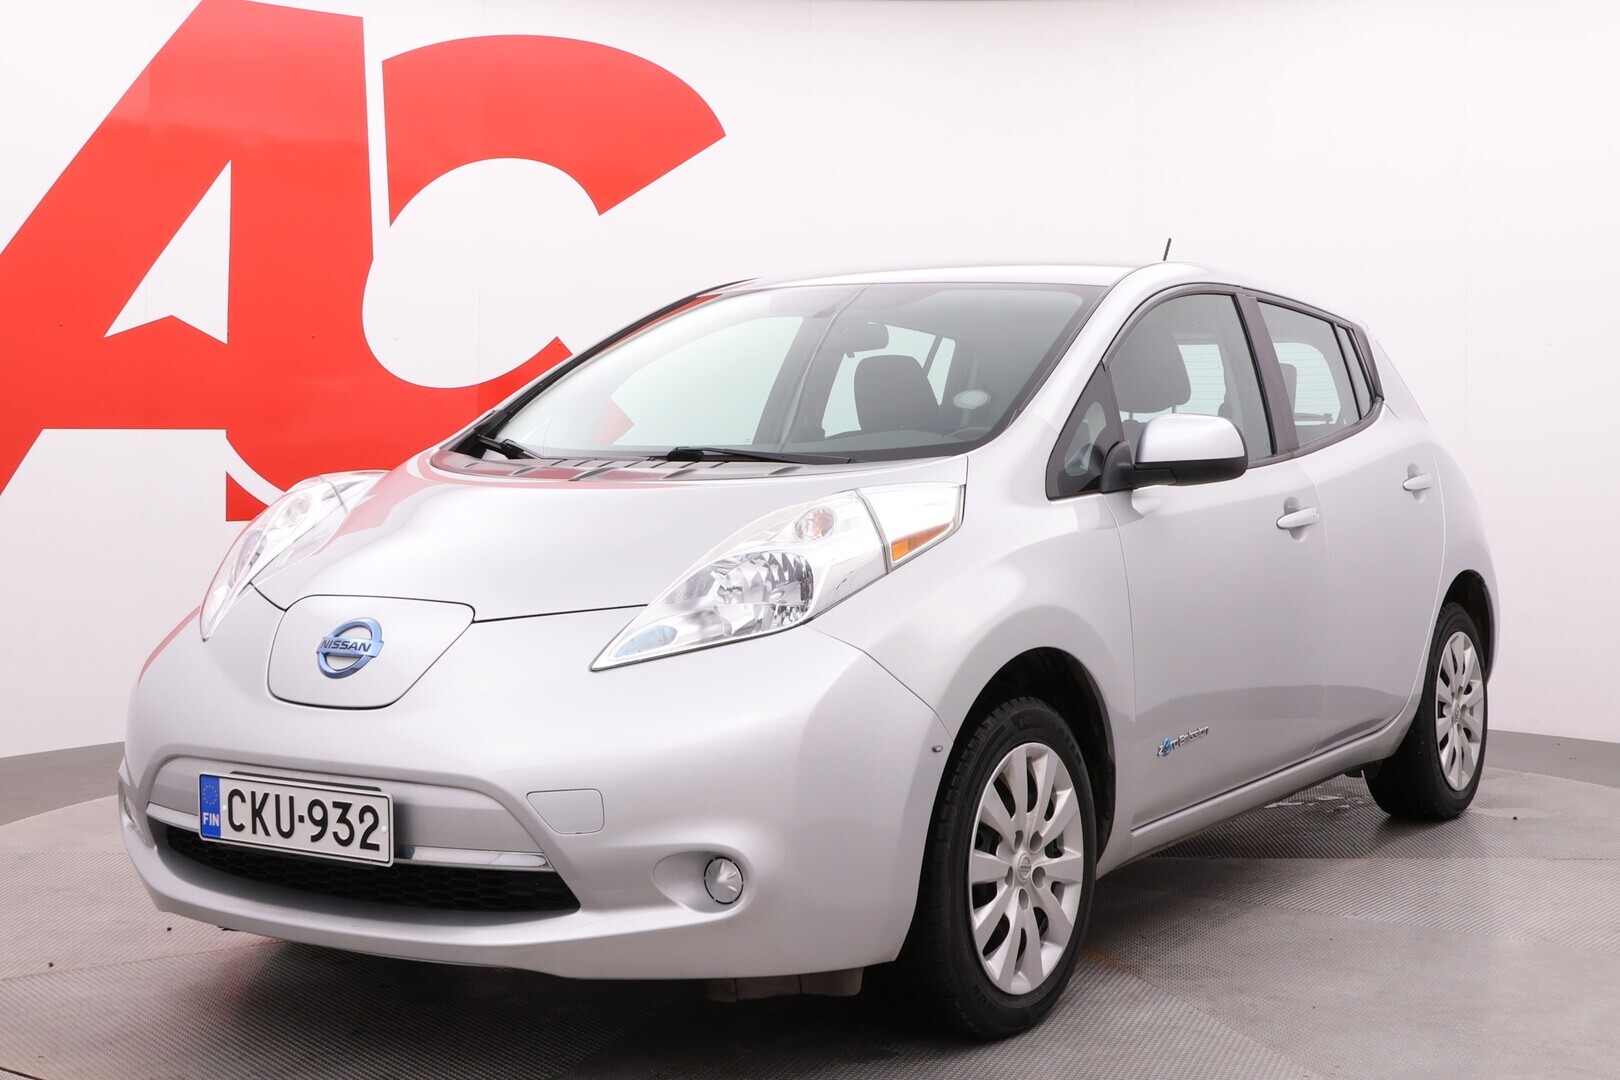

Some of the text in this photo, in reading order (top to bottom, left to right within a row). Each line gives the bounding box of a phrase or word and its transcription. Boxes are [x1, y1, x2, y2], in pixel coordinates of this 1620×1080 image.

[320, 640, 372, 653] NISSAN
[202, 812, 220, 827] FIN
[227, 788, 380, 852] CKU-932
